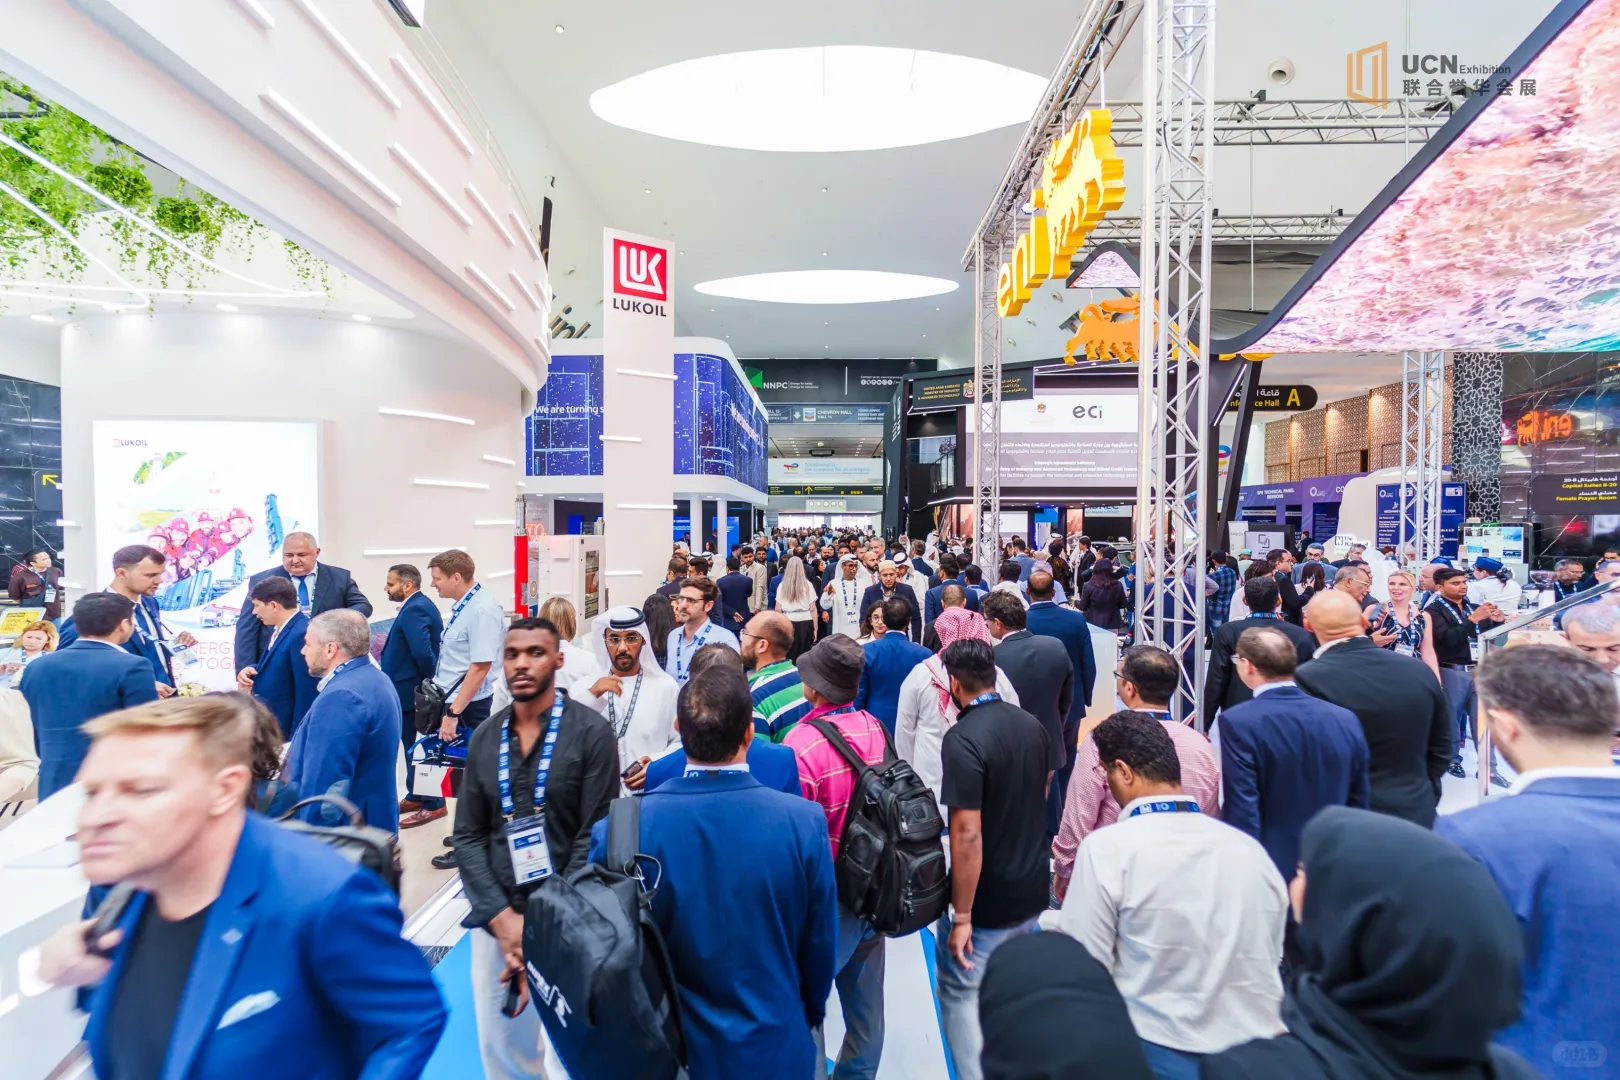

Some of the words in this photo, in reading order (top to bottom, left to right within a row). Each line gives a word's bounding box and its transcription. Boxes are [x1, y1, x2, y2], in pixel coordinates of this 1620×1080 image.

[613, 297, 667, 317] LUKOIL
[1260, 388, 1280, 397] قاعة
[1264, 398, 1280, 407] Hall
[1286, 388, 1301, 407] A
[535, 405, 549, 414] We
[550, 406, 565, 414] are
[566, 405, 598, 416] turning
[1072, 405, 1102, 419] eci
[120, 439, 148, 447] LUKOIL
